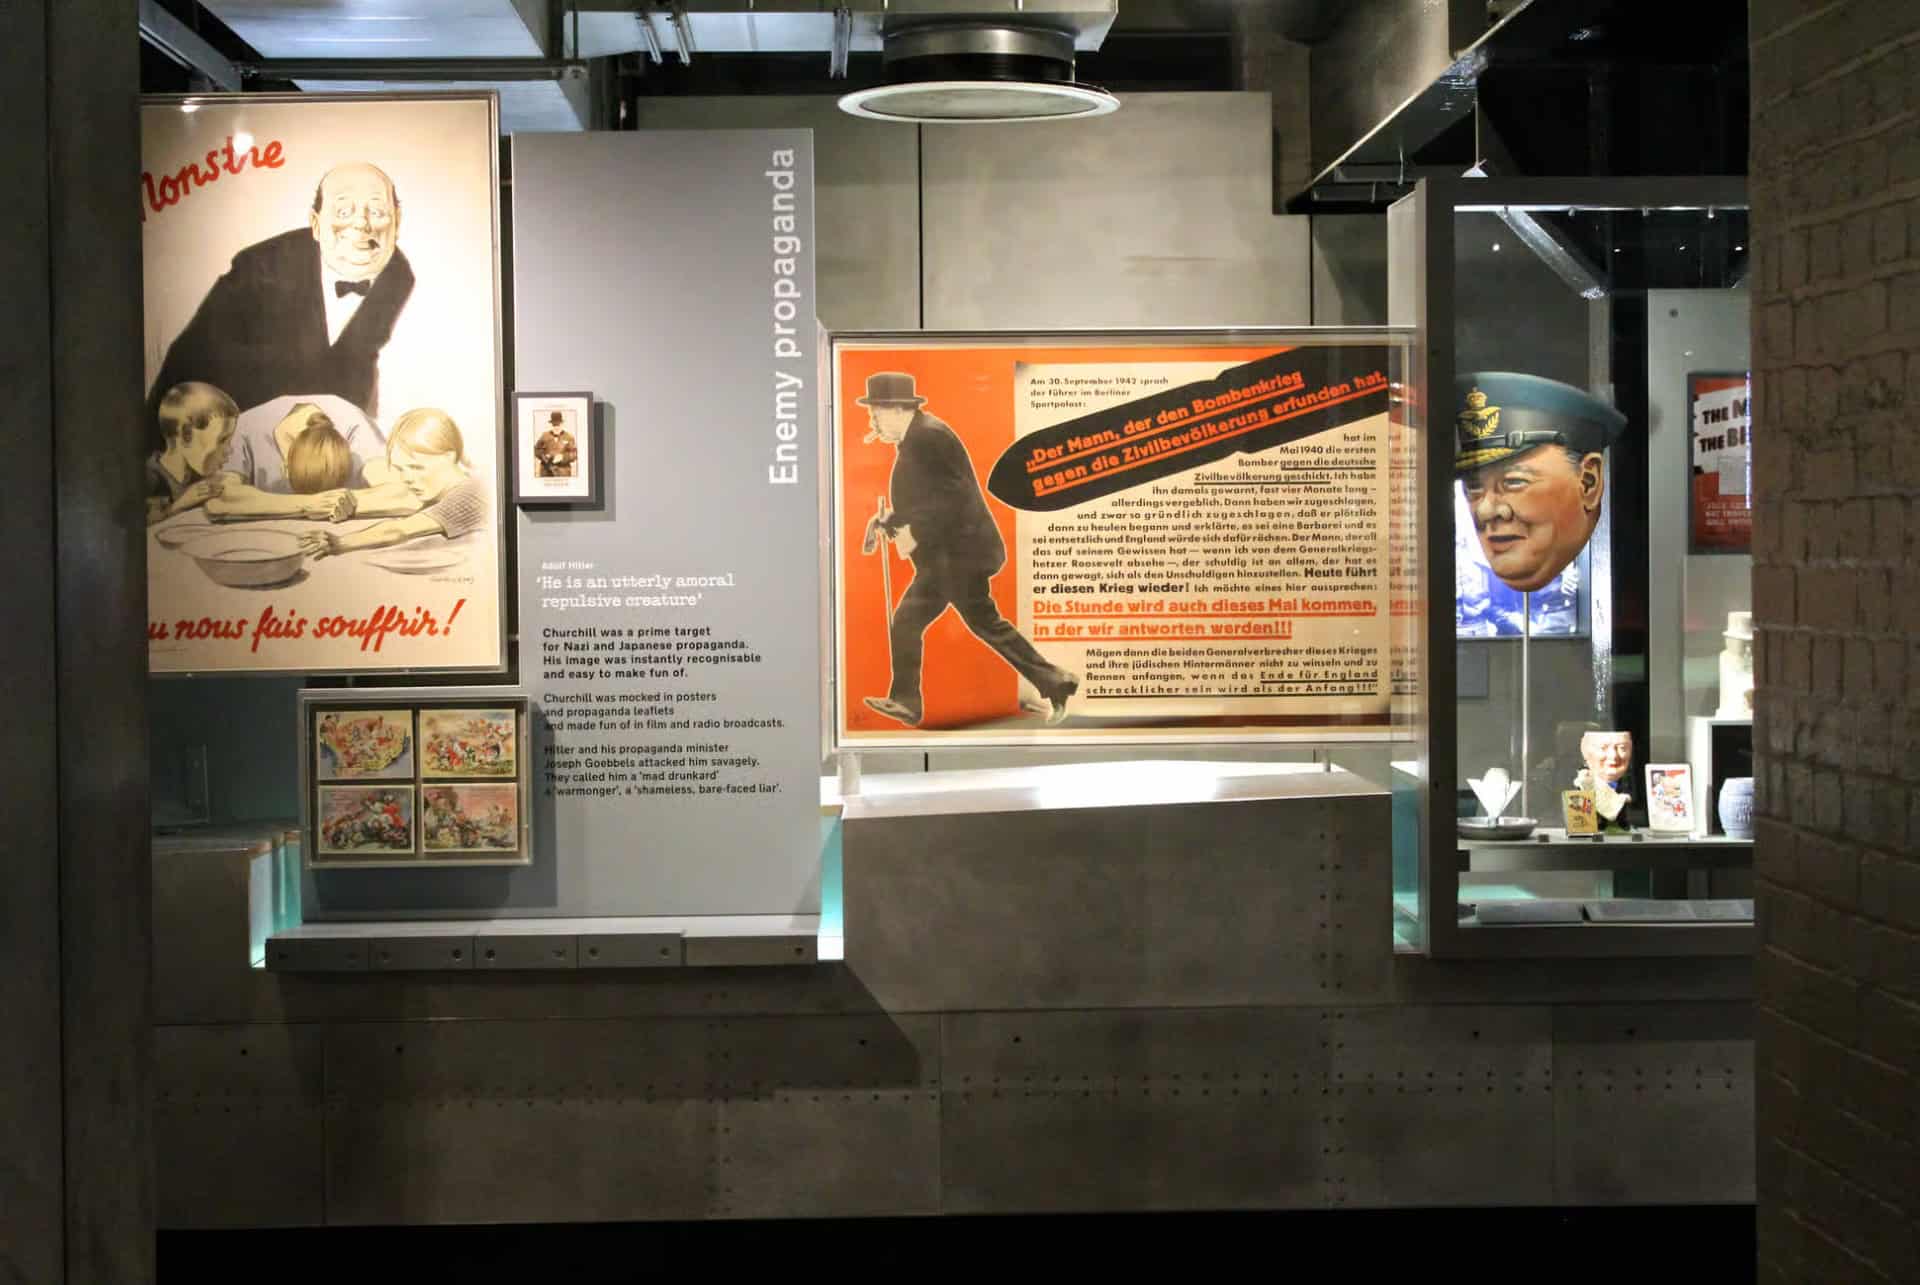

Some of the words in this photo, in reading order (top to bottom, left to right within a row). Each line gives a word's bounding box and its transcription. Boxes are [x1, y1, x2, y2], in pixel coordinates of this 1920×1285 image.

[765, 149, 801, 358] propaganda
[1064, 378, 1112, 386] September
[1140, 376, 1169, 386] sprach
[1067, 429, 1120, 452] Mann,
[1124, 417, 1153, 436] der
[1158, 406, 1189, 427] den
[1194, 372, 1303, 413] Bombenkrieg
[1702, 408, 1729, 424] THE
[769, 371, 804, 485] Enemy
[1032, 463, 1088, 491] gegen
[1091, 455, 1120, 473] die
[1124, 410, 1270, 462] Zivilbevölkerung
[1273, 384, 1351, 416] erfunden
[1355, 372, 1388, 390] hat.
[1343, 433, 1360, 442] hat
[1699, 435, 1726, 452] THE
[1326, 446, 1342, 454] die
[1238, 459, 1278, 467] Bomber
[1280, 459, 1312, 467] gegen
[1194, 472, 1281, 482] Zivilbevölkerung
[1284, 472, 1333, 481] geschickt.
[1334, 472, 1349, 480] Ich
[1350, 472, 1376, 480] habe
[1111, 498, 1164, 507] allerdings
[1165, 497, 1222, 507] vergeblich.
[1224, 498, 1252, 506] Dann
[1304, 497, 1377, 507] zugeschlagen,
[1304, 568, 1343, 577] Heute
[1345, 567, 1377, 577] führt
[536, 576, 562, 589] 'He
[566, 576, 582, 589] is
[586, 577, 608, 589] an
[612, 575, 672, 591] utterly
[675, 573, 736, 587] amoral
[1033, 586, 1047, 594] er
[1051, 584, 1095, 593] diesen
[1099, 584, 1134, 594] Krieg
[1138, 583, 1189, 593] wieder!
[1194, 584, 1208, 592] Ich
[1213, 584, 1250, 592] möchte
[1256, 584, 1281, 592] eines
[1286, 583, 1307, 592] hier
[1311, 583, 1377, 592] aussprechen:
[542, 595, 621, 610] repulsive
[625, 593, 703, 607] creature'
[1033, 601, 1063, 614] Die
[1065, 601, 1123, 614] Stunde
[1127, 601, 1162, 614] wird
[1168, 601, 1208, 613] auch
[1212, 600, 1265, 613] dieses
[1269, 600, 1297, 612] Mal
[1301, 599, 1377, 612] kommen,
[147, 621, 169, 640] u
[174, 617, 249, 640] nous
[251, 605, 308, 652] fais
[312, 598, 467, 652] souffrir!
[1033, 623, 1049, 636] in
[1055, 623, 1083, 636] der
[1089, 623, 1112, 636] wir
[1119, 623, 1204, 636] antworten
[1210, 621, 1293, 635] werden!!!
[543, 628, 597, 638] Churchill
[600, 629, 624, 637] was
[627, 629, 634, 637] a
[638, 627, 671, 639] prime
[674, 627, 711, 637] target
[543, 642, 559, 651] for
[564, 642, 589, 651] Nazi
[594, 641, 615, 650] and
[619, 641, 672, 652] Japanese
[676, 640, 750, 650] propaganda.
[1086, 649, 1122, 657] Mögen
[1123, 649, 1150, 657] dann
[1169, 648, 1205, 656] beiden
[1206, 647, 1303, 656] Generalverbrecher
[1305, 647, 1337, 655] dieses
[1338, 647, 1378, 656] Krieges
[543, 655, 562, 665] His
[565, 655, 600, 666] image
[604, 656, 627, 664] was
[631, 654, 683, 665] instantly
[687, 653, 761, 664] recognisable
[544, 669, 565, 679] and
[568, 671, 595, 680] easy
[600, 669, 611, 678] to
[615, 669, 645, 678] make
[650, 668, 670, 678] fun
[673, 668, 688, 678] of.
[543, 693, 592, 703] Churchill
[595, 694, 616, 702] was
[619, 693, 661, 702] mocked
[664, 692, 673, 701] in
[676, 692, 717, 702] posters
[544, 707, 564, 717] and
[567, 707, 630, 718] propaganda
[633, 706, 675, 716] leaflets
[544, 721, 564, 731] and
[567, 721, 596, 730] made
[600, 721, 617, 730] fun
[620, 721, 631, 730] of
[634, 720, 644, 729] in
[646, 720, 667, 729] film
[670, 720, 690, 729] and
[693, 719, 721, 728] radio
[723, 718, 785, 728] broadcasts.
[544, 745, 575, 755] Hitler
[579, 745, 598, 754] and
[601, 745, 617, 754] his
[619, 744, 683, 755] propaganda
[687, 744, 729, 753] minister
[544, 759, 582, 770] Joseph
[585, 758, 635, 768] Goebbels
[638, 758, 686, 767] attacked
[689, 757, 708, 766] him
[711, 757, 760, 767] savagely.
[546, 772, 570, 783] They
[573, 772, 605, 782] called
[608, 772, 628, 781] him
[631, 773, 637, 781] a
[639, 771, 665, 781] 'mad
[668, 770, 719, 780] drunkard'
[545, 788, 551, 796] a
[553, 785, 622, 797] 'warmonger',
[625, 787, 631, 795] a
[634, 785, 696, 795] 'shameless,
[699, 784, 756, 794] bare-faced
[759, 783, 783, 793] liar'.
